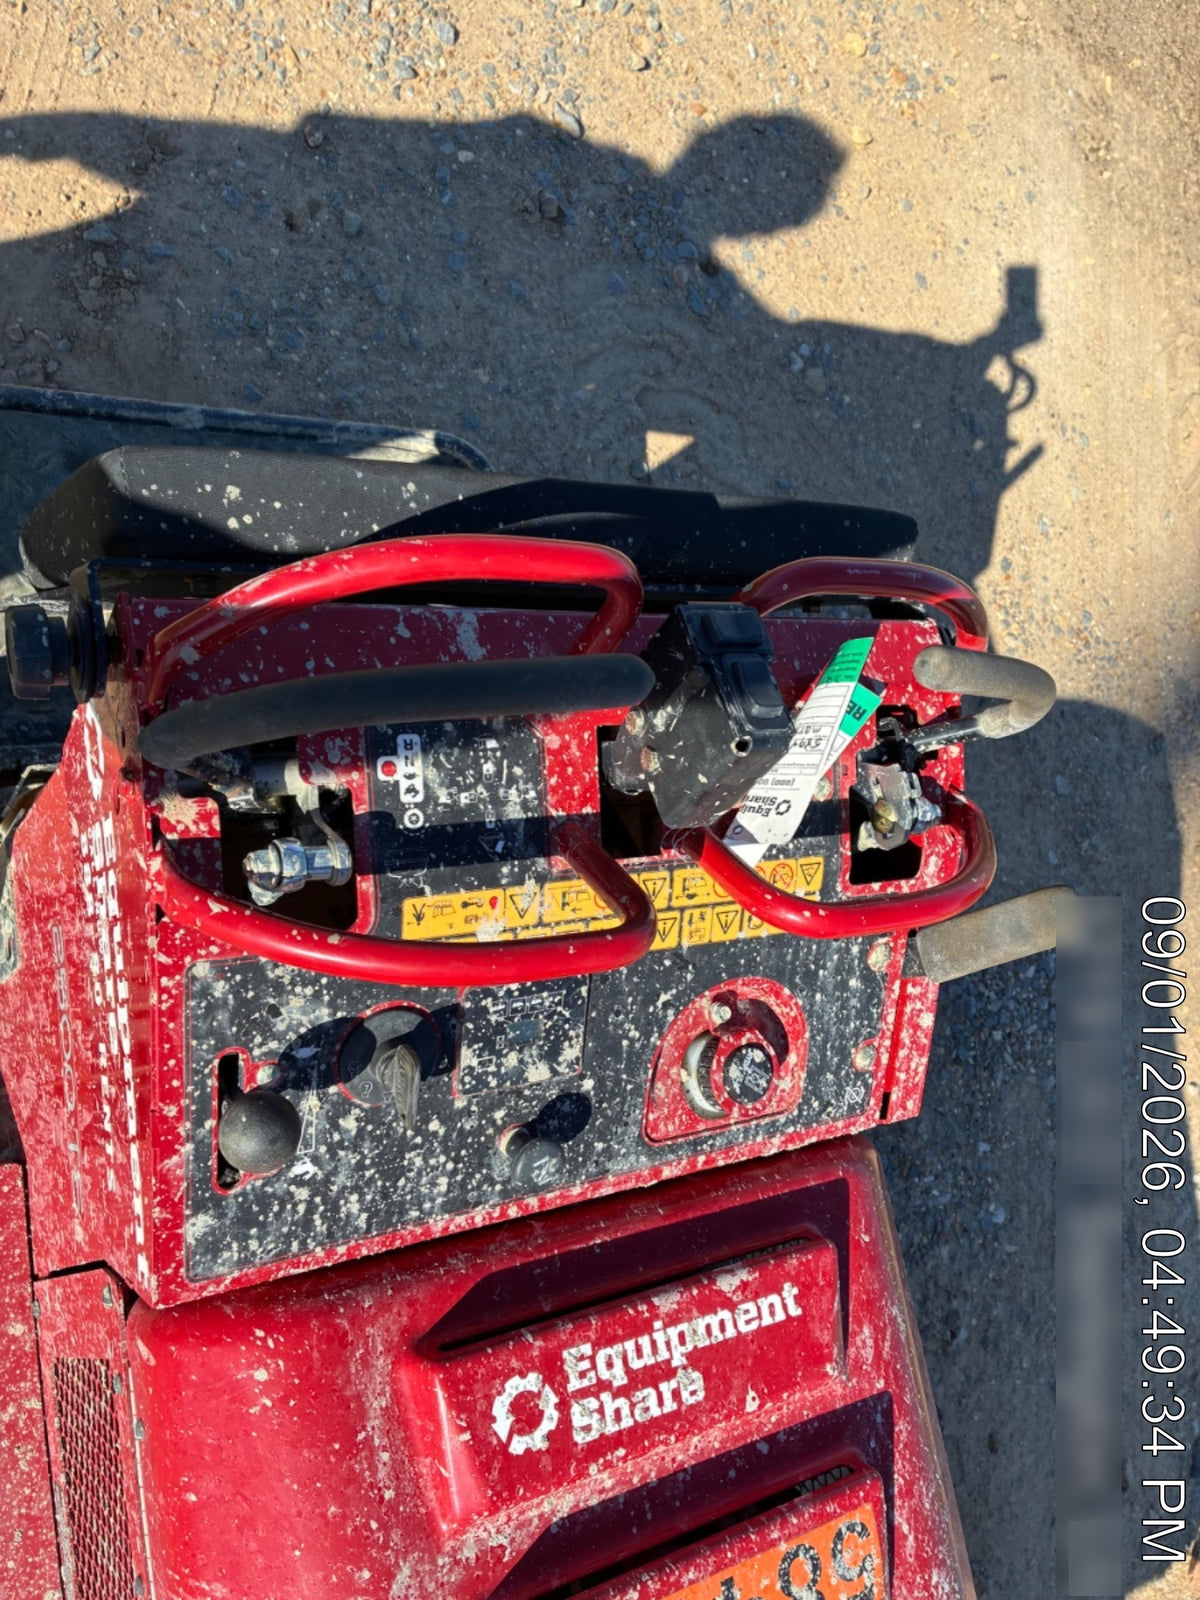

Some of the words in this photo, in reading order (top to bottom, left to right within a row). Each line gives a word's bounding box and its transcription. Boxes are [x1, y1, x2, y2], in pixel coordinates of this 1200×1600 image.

[404, 739, 413, 750] R
[404, 755, 414, 767] N
[92, 820, 118, 1057] Share
[102, 811, 150, 1290] Equipment
[98, 1042, 116, 1194] RENTS
[562, 1282, 803, 1392] Equipment
[571, 1366, 704, 1444] Share
[711, 1520, 876, 1600] 89
